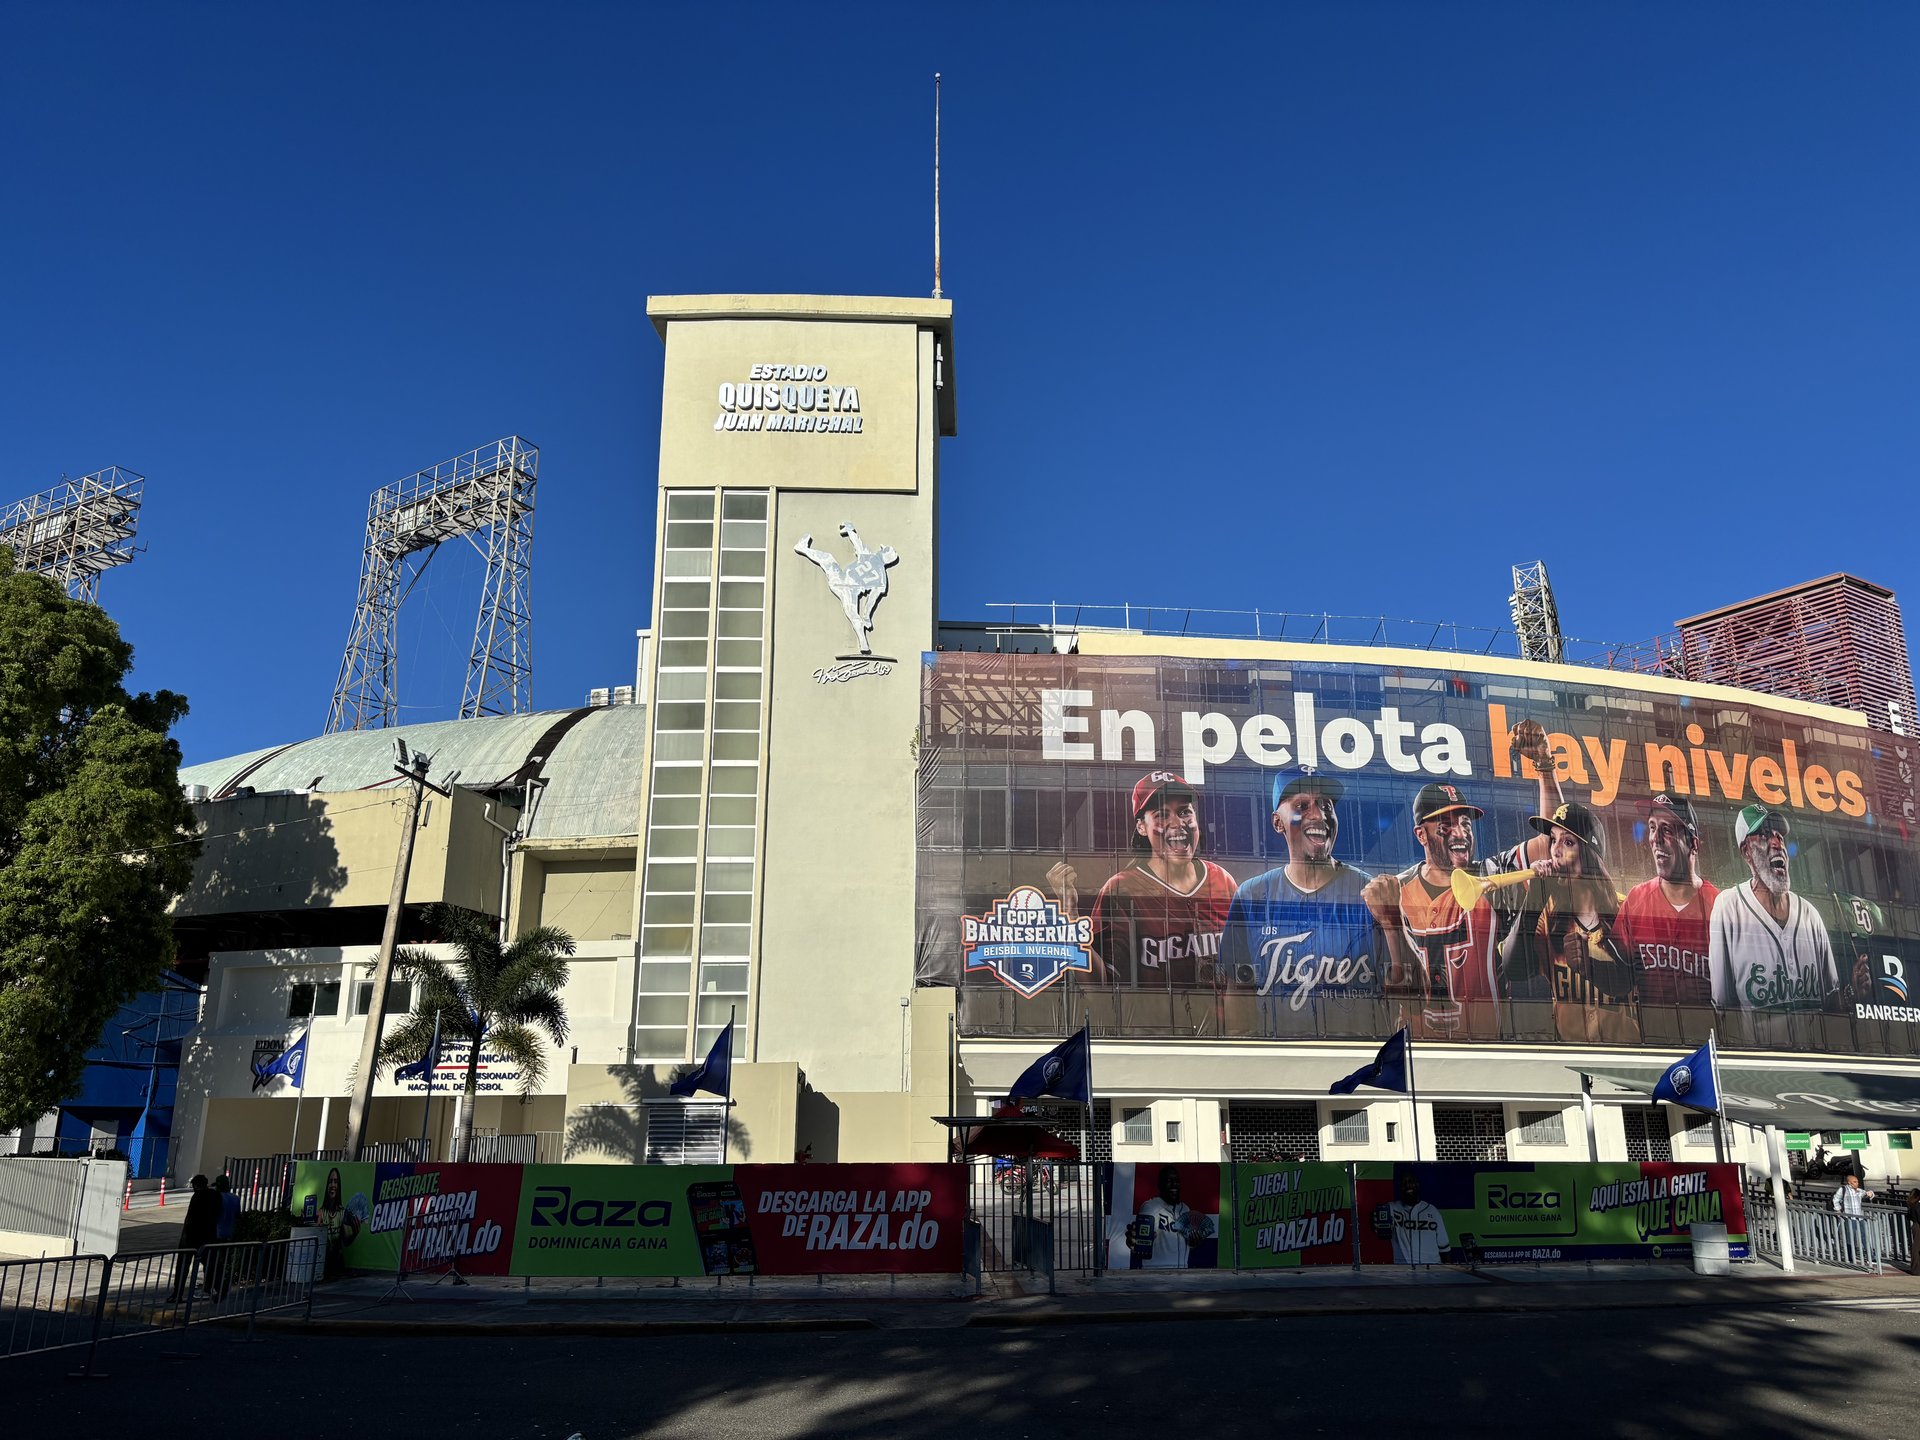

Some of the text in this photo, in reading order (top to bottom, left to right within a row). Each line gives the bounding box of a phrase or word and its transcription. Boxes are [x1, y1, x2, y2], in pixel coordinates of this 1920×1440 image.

[750, 364, 827, 381] ESTADIO
[718, 383, 860, 412] QUISQUEYA
[714, 414, 863, 433] JUAN MARICHAL
[855, 561, 880, 583] 27
[1042, 690, 1155, 761] En
[1181, 692, 1472, 785] pelota
[1488, 704, 1627, 806] hay
[1645, 723, 1867, 817] niveles
[1007, 910, 1047, 926] COPA
[965, 919, 1090, 943] BANRESERVAS
[1262, 926, 1277, 935] LOS
[1025, 946, 1072, 957] INVERNAL
[1257, 931, 1374, 1011] Tigres
[440, 1072, 457, 1080] DEL
[453, 1083, 465, 1091] DE
[1249, 1169, 1302, 1198] JUEGA Y
[1590, 1171, 1707, 1211] AQUÍ ESTÁ LA GENTE
[531, 1186, 672, 1226] Raza
[758, 1190, 932, 1213] DESCARGA LA APP
[1243, 1186, 1344, 1226] GANA EN VIVO
[1488, 1184, 1560, 1209] Raza
[370, 1200, 408, 1233] GANA
[411, 1197, 424, 1226] Y
[1490, 1214, 1562, 1223] DOMINICANA GANA
[1637, 1191, 1722, 1238] QUE GANA
[528, 1237, 668, 1249] DOMINICANA GANA
[782, 1213, 939, 1250] DE RAZA.do
[1256, 1212, 1345, 1253] EN RAZA.do
[1484, 1251, 1507, 1259] DESCARGA
[1532, 1248, 1561, 1259] RAZA.do
